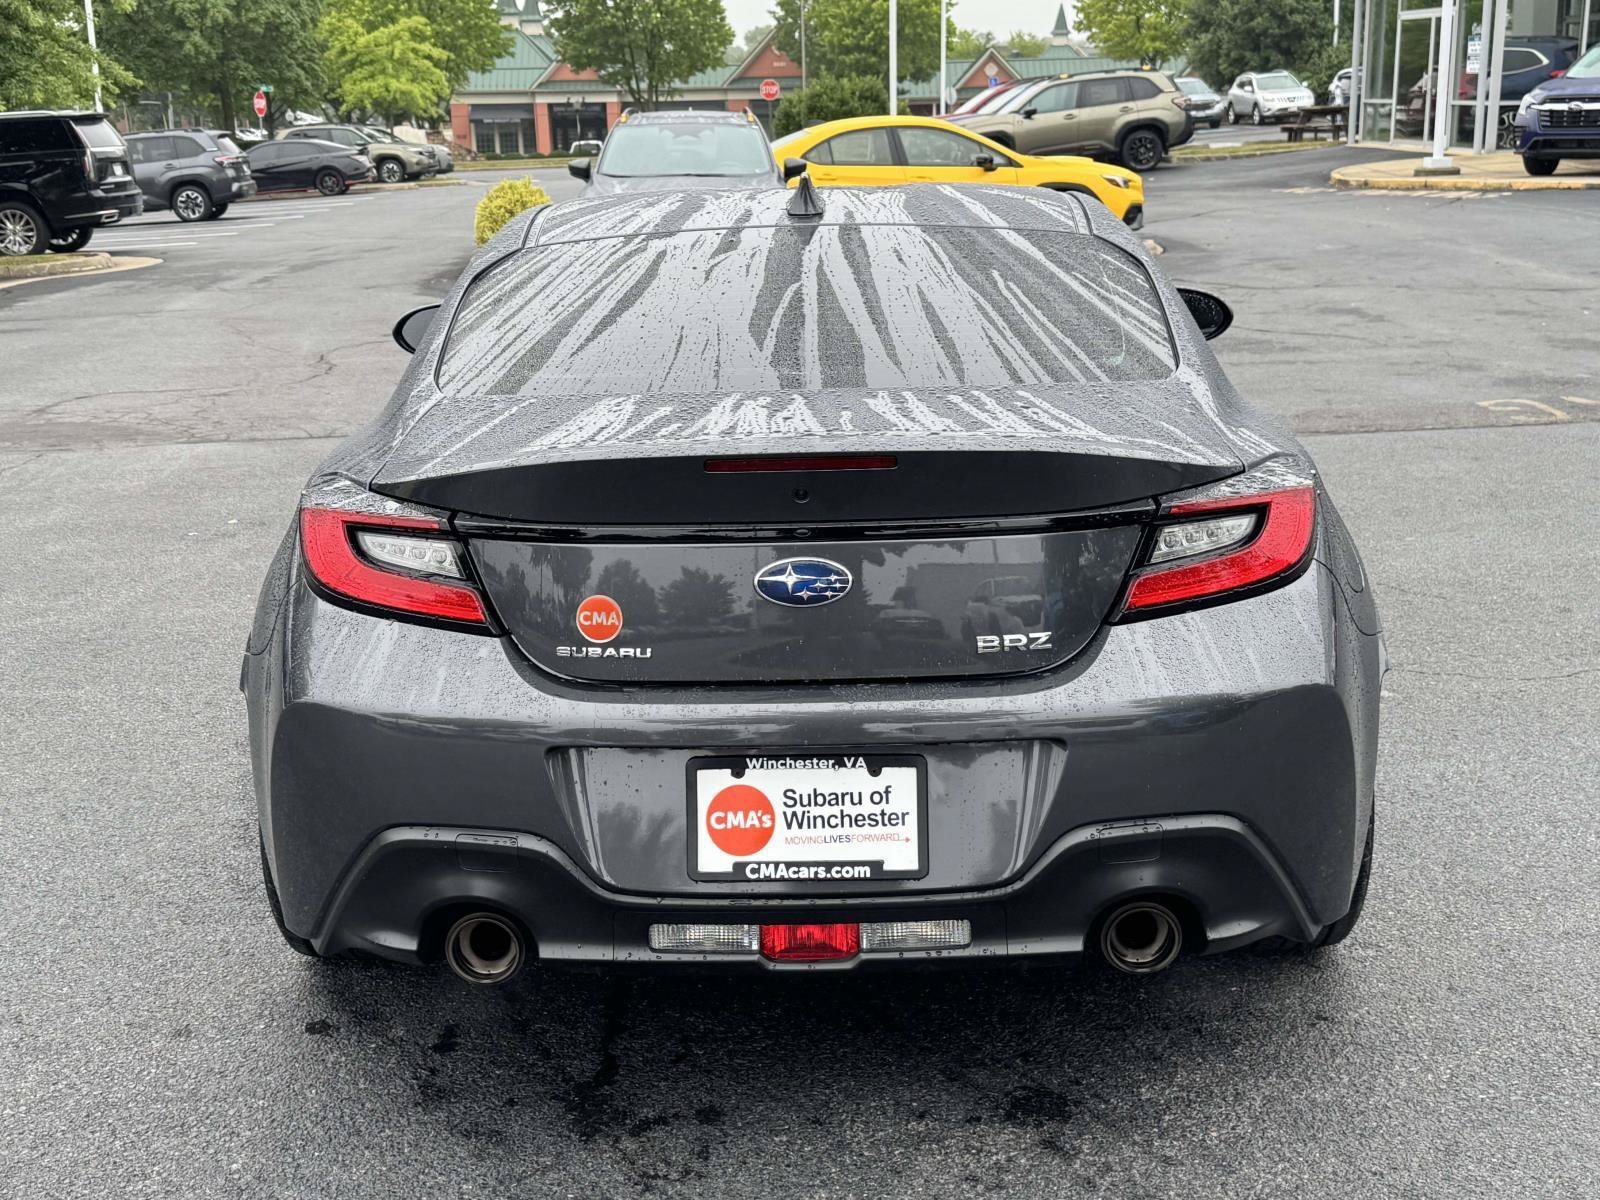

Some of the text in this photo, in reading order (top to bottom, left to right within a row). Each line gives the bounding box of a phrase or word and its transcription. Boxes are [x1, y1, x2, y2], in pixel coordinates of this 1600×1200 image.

[579, 611, 619, 626] CMA
[976, 632, 1052, 653] BRZ
[556, 646, 652, 658] SUBARU
[746, 756, 867, 771] Winchester, VA
[783, 785, 892, 808] Subaru of
[709, 811, 773, 830] CMA's
[783, 809, 910, 830] Winchester
[745, 863, 871, 880] CMAcars.com
